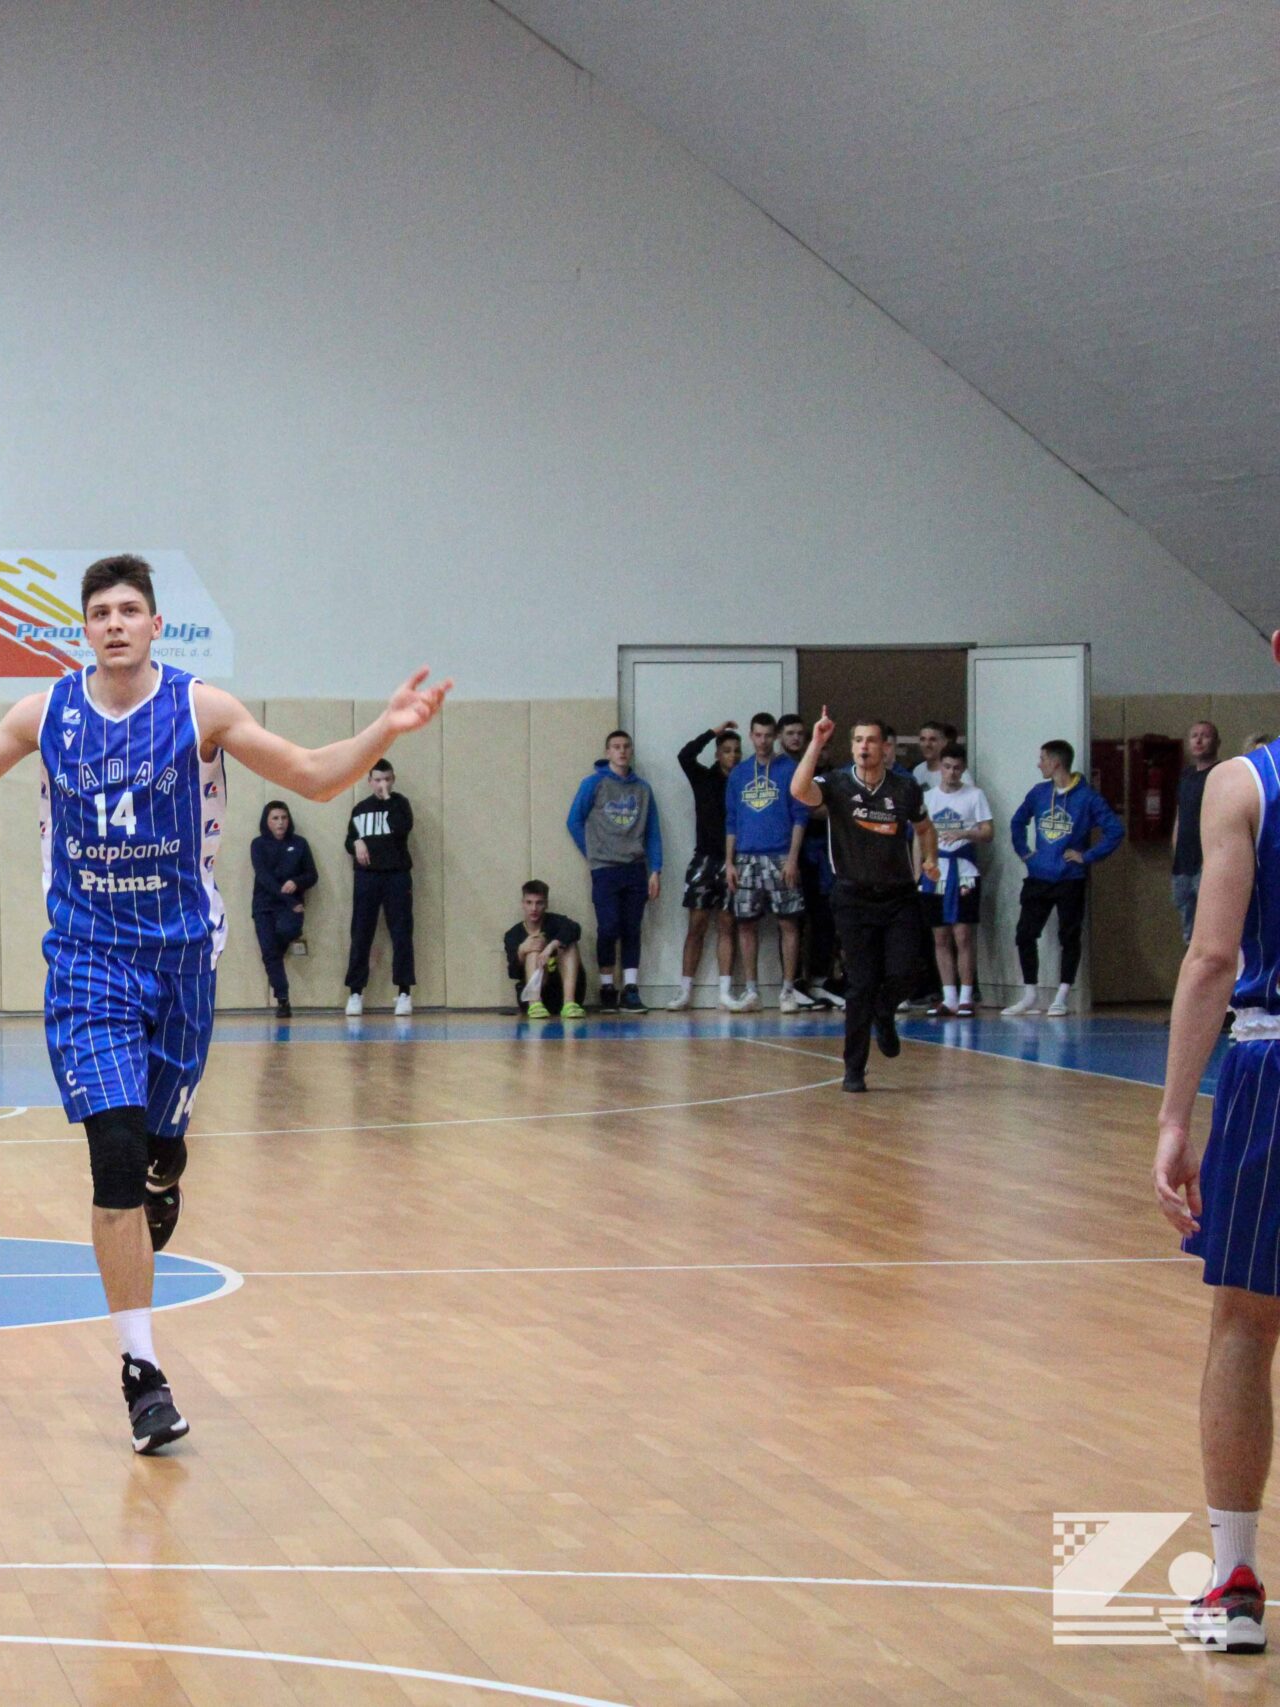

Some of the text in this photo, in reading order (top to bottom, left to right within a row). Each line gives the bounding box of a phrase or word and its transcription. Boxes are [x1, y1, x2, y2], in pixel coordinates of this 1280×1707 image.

[163, 623, 212, 643] blja
[151, 647, 187, 657] HOTEL
[54, 758, 178, 797] ZADAR
[94, 791, 137, 837] 14
